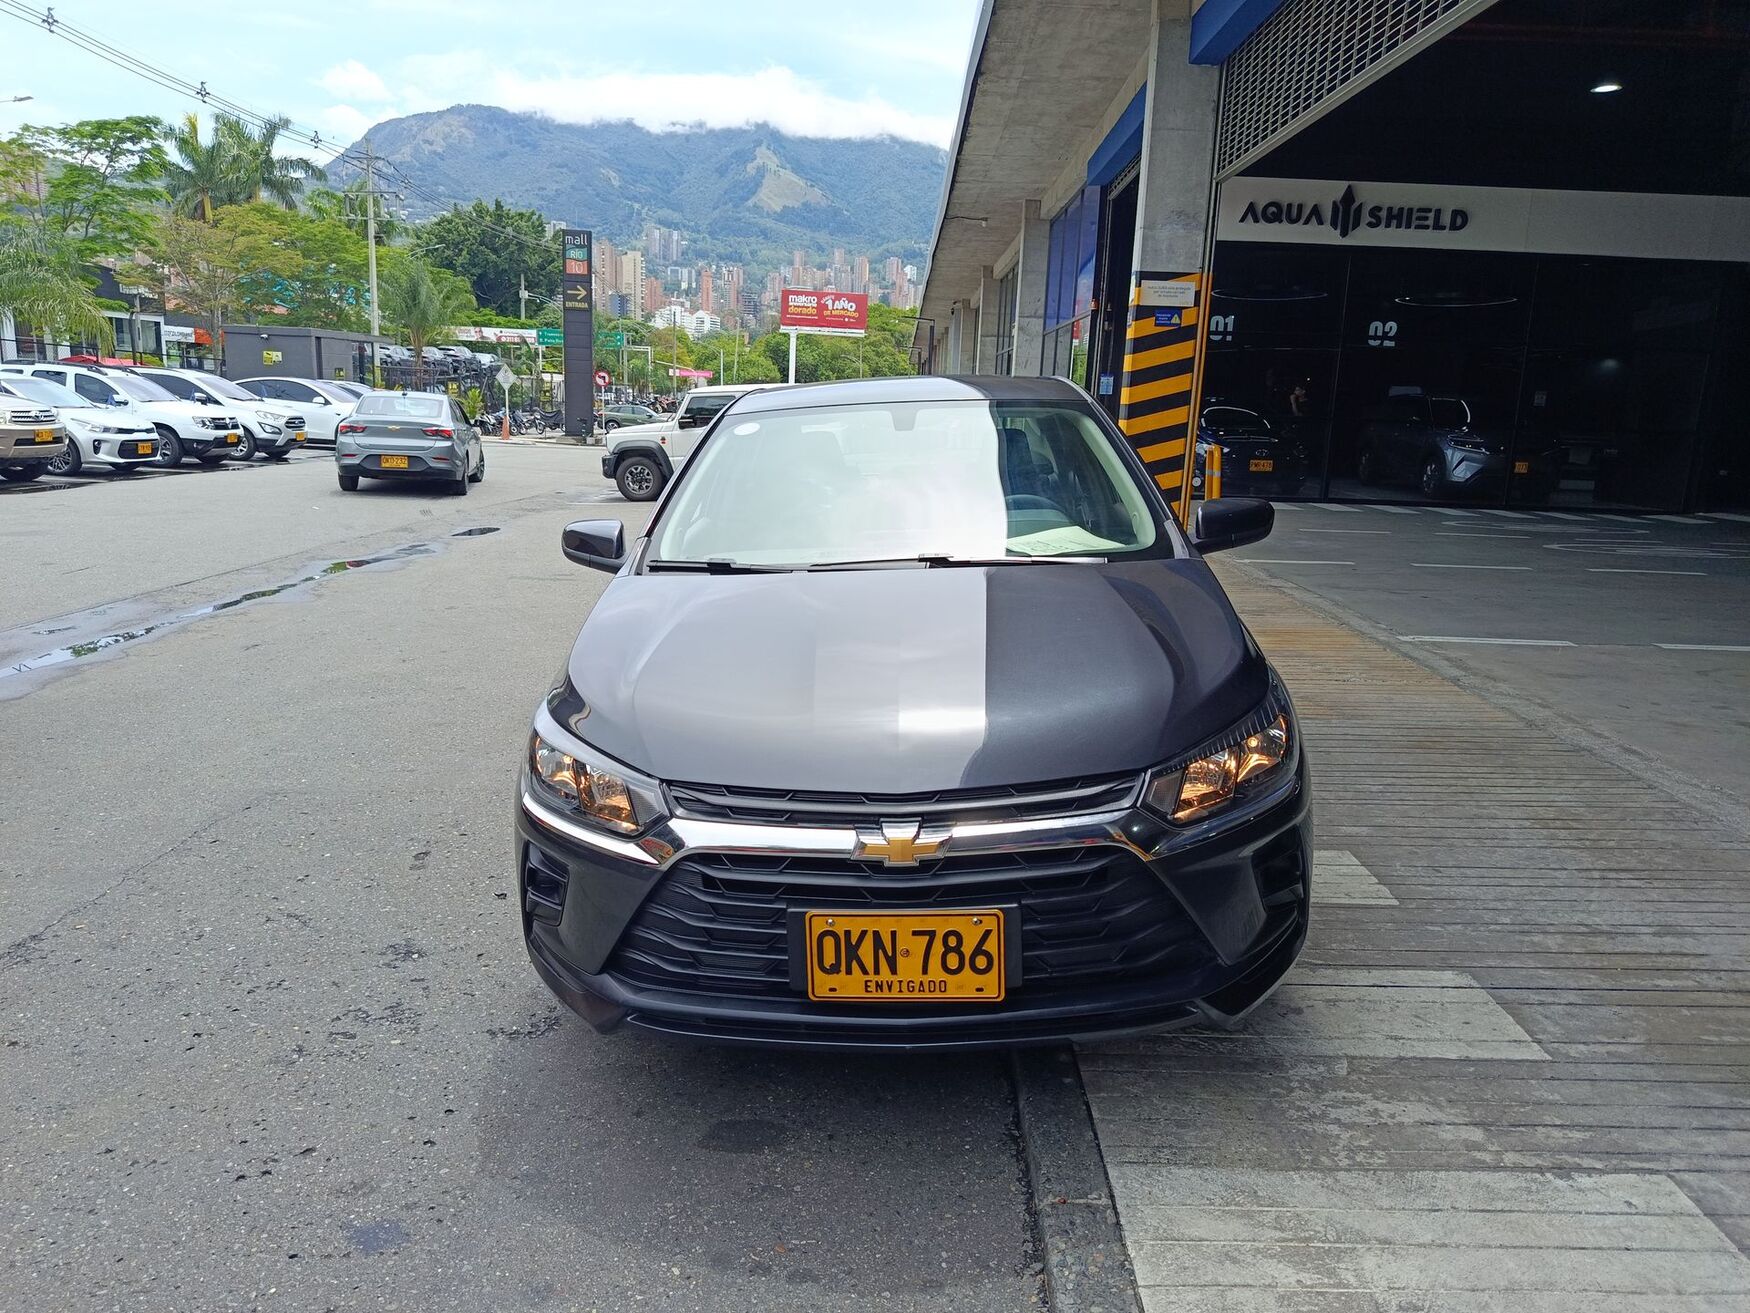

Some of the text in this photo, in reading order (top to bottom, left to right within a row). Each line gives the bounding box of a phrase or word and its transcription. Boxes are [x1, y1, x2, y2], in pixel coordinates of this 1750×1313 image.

[1239, 201, 1469, 232] AQUA SHIELD
[565, 234, 588, 245] mall
[570, 262, 583, 274] 10
[565, 301, 588, 309] ENTRADA
[788, 294, 818, 303] makro
[825, 298, 833, 310] 1
[833, 297, 856, 311] AÑO
[788, 306, 817, 314] dorado
[1209, 315, 1235, 341] 01
[1368, 321, 1398, 347] 02
[816, 929, 994, 976] QKN 786
[864, 979, 947, 993] ENVIGADO
